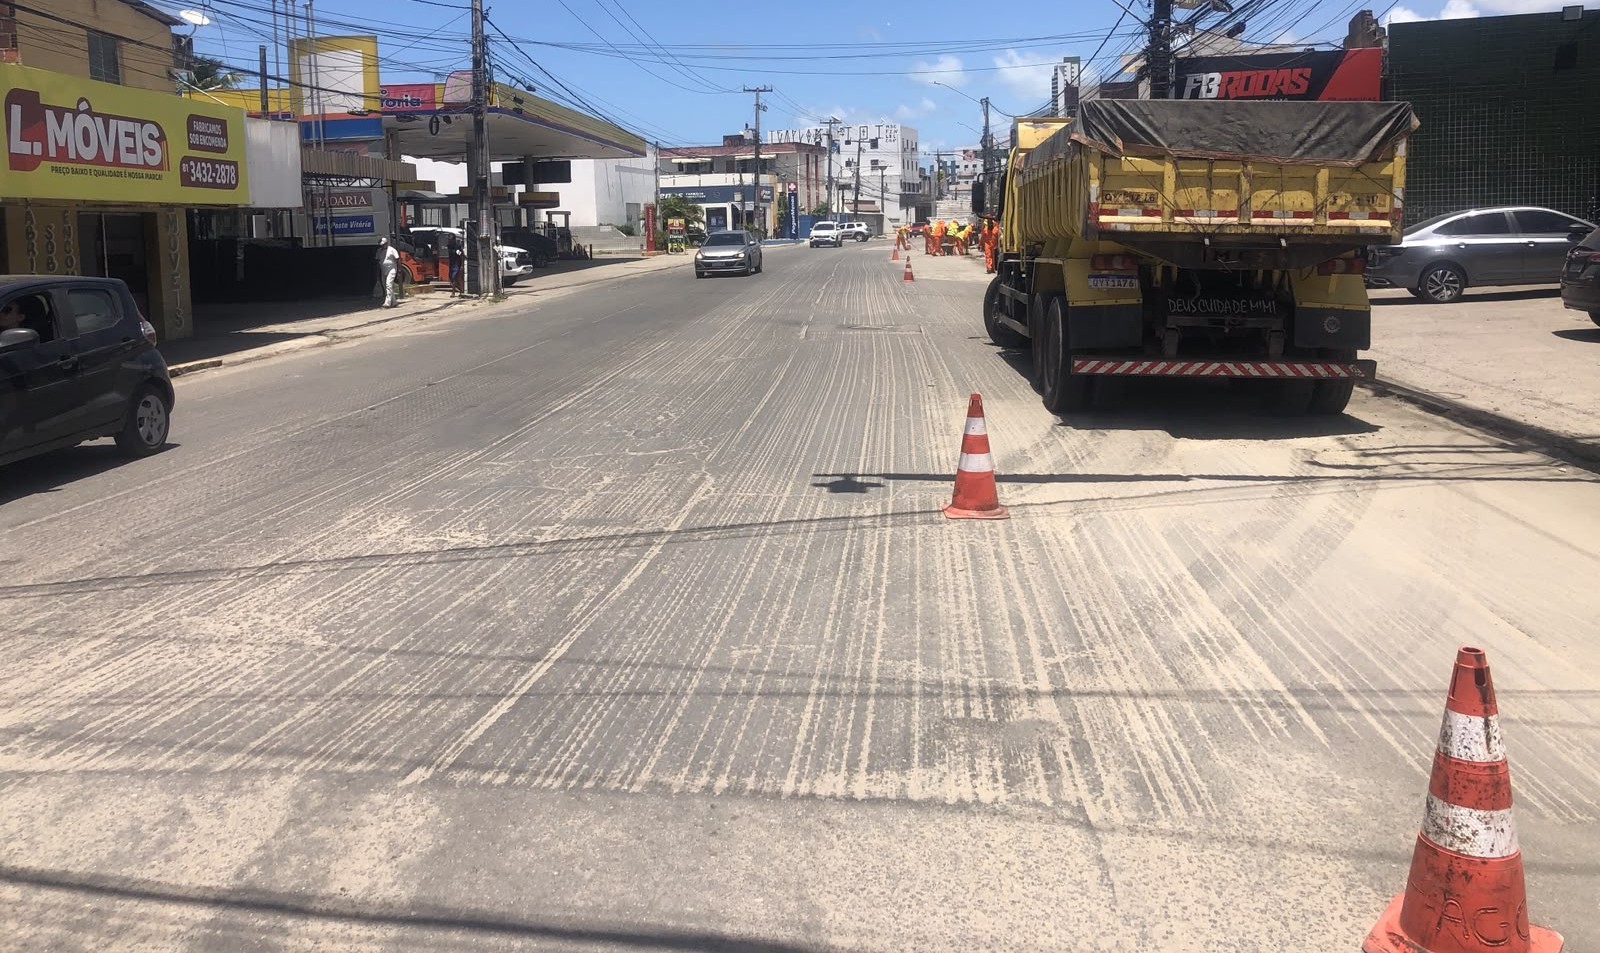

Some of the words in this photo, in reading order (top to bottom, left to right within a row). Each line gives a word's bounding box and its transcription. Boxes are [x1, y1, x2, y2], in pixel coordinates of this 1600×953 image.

[10, 104, 42, 155] L.
[45, 101, 162, 166] MÓVEIS
[193, 121, 222, 135] FABRICAMOS
[189, 133, 199, 145] SOB
[200, 135, 227, 148] ENCOMENDA
[51, 166, 70, 176] PREÇO
[71, 168, 88, 176] BAIXO
[93, 169, 123, 178] QUALIDADE
[128, 171, 144, 179] NOSSA
[182, 163, 189, 173] 81
[189, 161, 236, 184] 3432-2878
[350, 220, 371, 229] Vitória
[1168, 299, 1197, 313] DEUS
